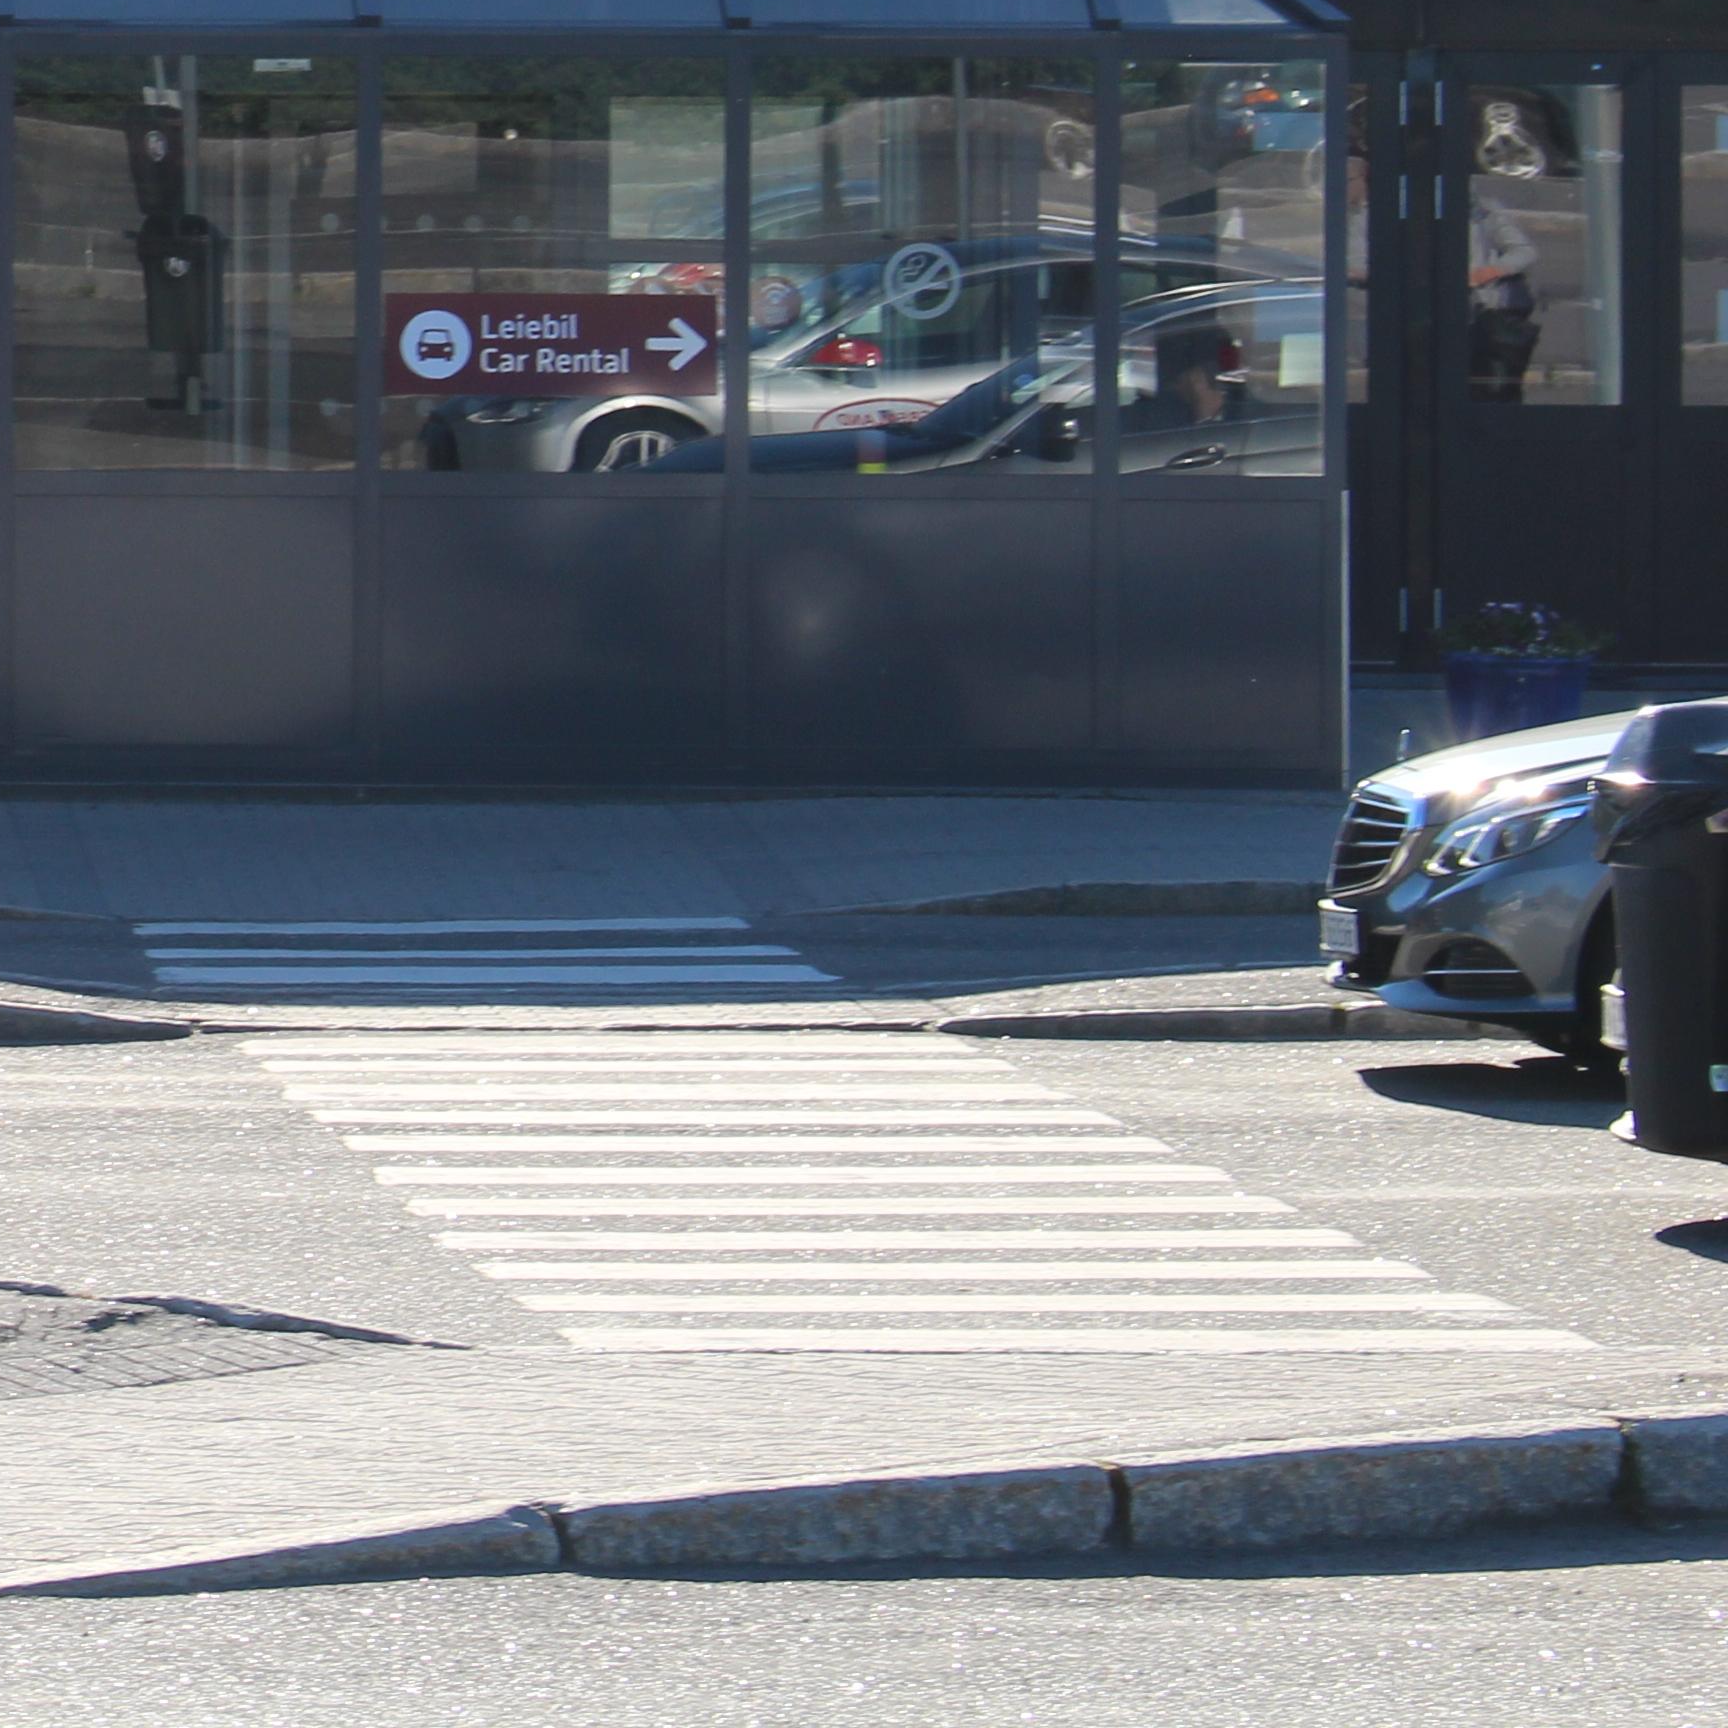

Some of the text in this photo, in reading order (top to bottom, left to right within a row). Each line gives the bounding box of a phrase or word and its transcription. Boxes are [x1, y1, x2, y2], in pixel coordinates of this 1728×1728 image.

[480, 314, 577, 340] Leiebil
[479, 348, 630, 374] Car Rental
